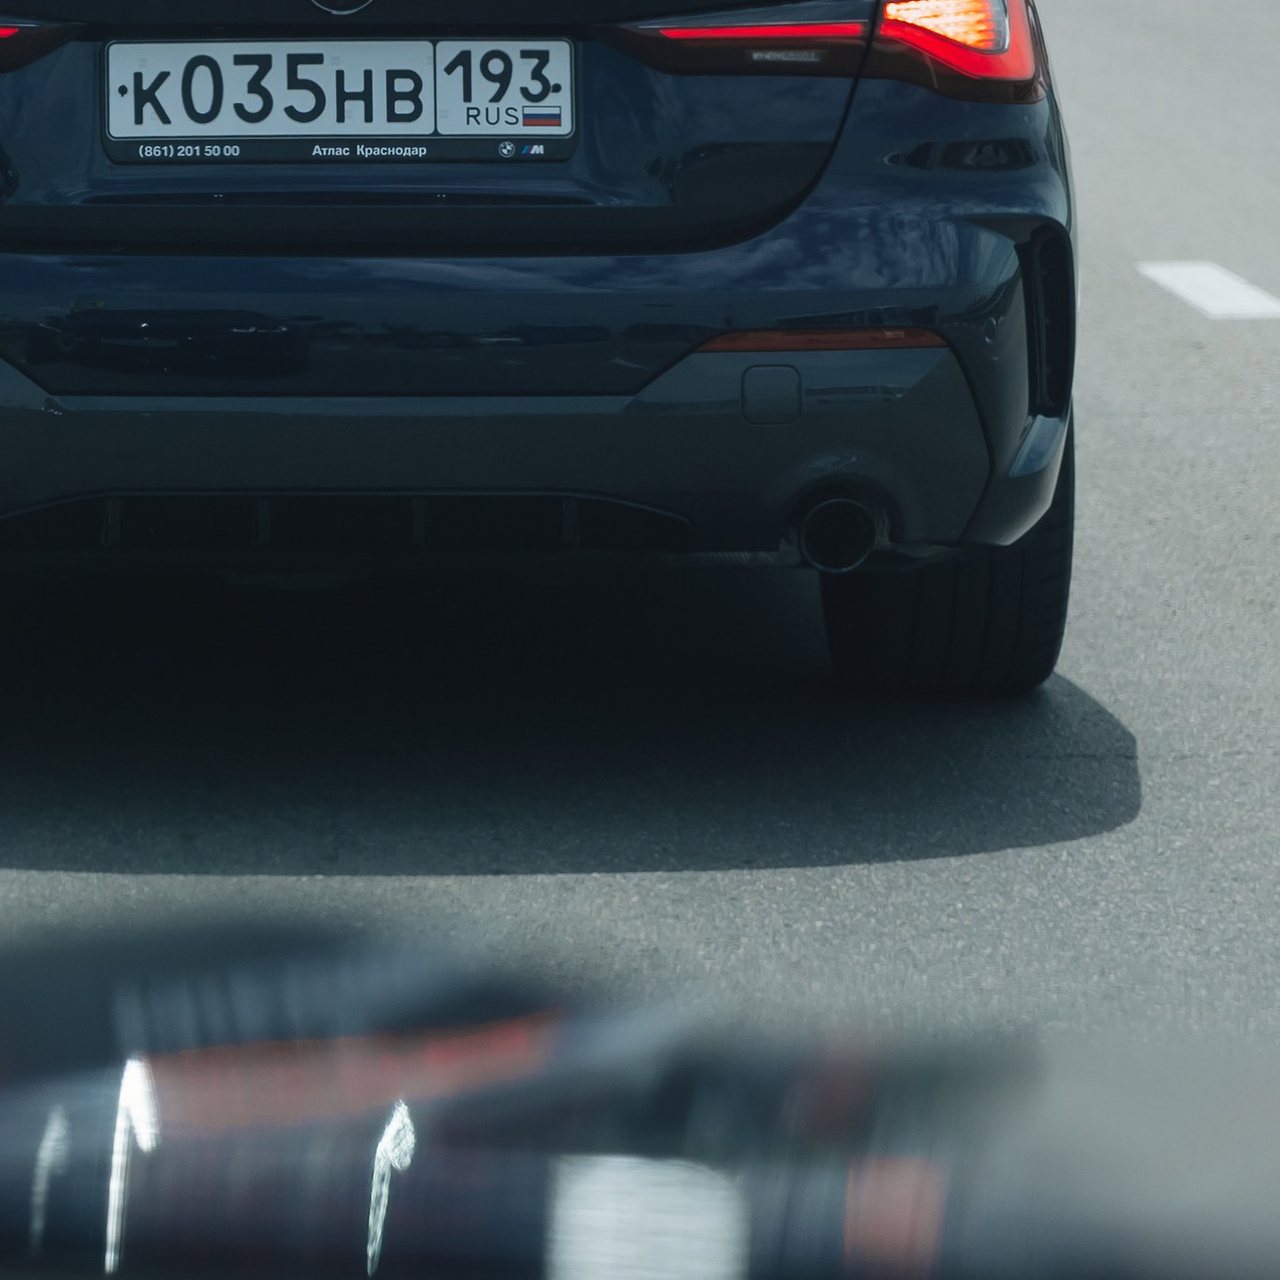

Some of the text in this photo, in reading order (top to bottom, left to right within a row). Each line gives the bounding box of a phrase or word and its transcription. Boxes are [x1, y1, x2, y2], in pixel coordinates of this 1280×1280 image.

[442, 49, 552, 103] 193
[466, 106, 520, 126] RUS
[138, 145, 240, 158] (861) 201 50 00
[312, 144, 427, 158] Атлас Краснодар
